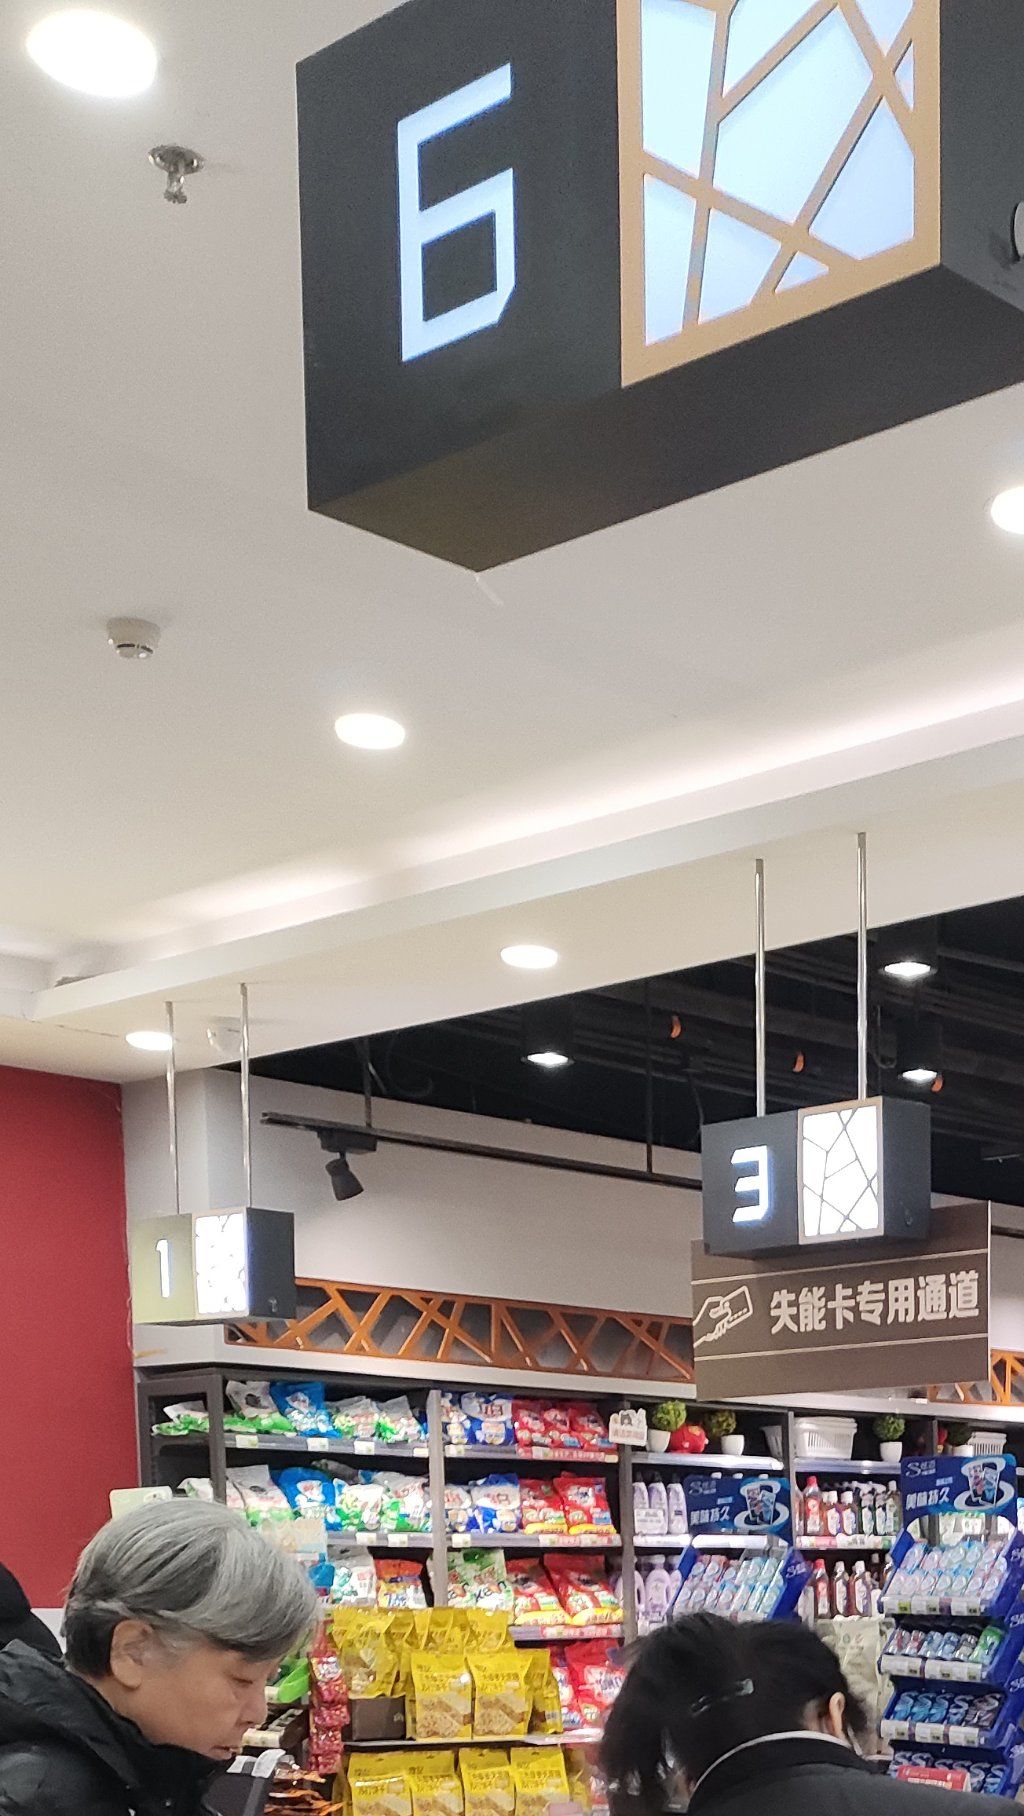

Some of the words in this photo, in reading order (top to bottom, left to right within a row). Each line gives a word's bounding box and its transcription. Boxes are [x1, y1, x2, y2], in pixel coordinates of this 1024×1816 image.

[396, 62, 517, 363] 6
[731, 1144, 769, 1223] 3
[154, 1238, 171, 1298] 1
[770, 1269, 979, 1335] 失能卡专用通道
